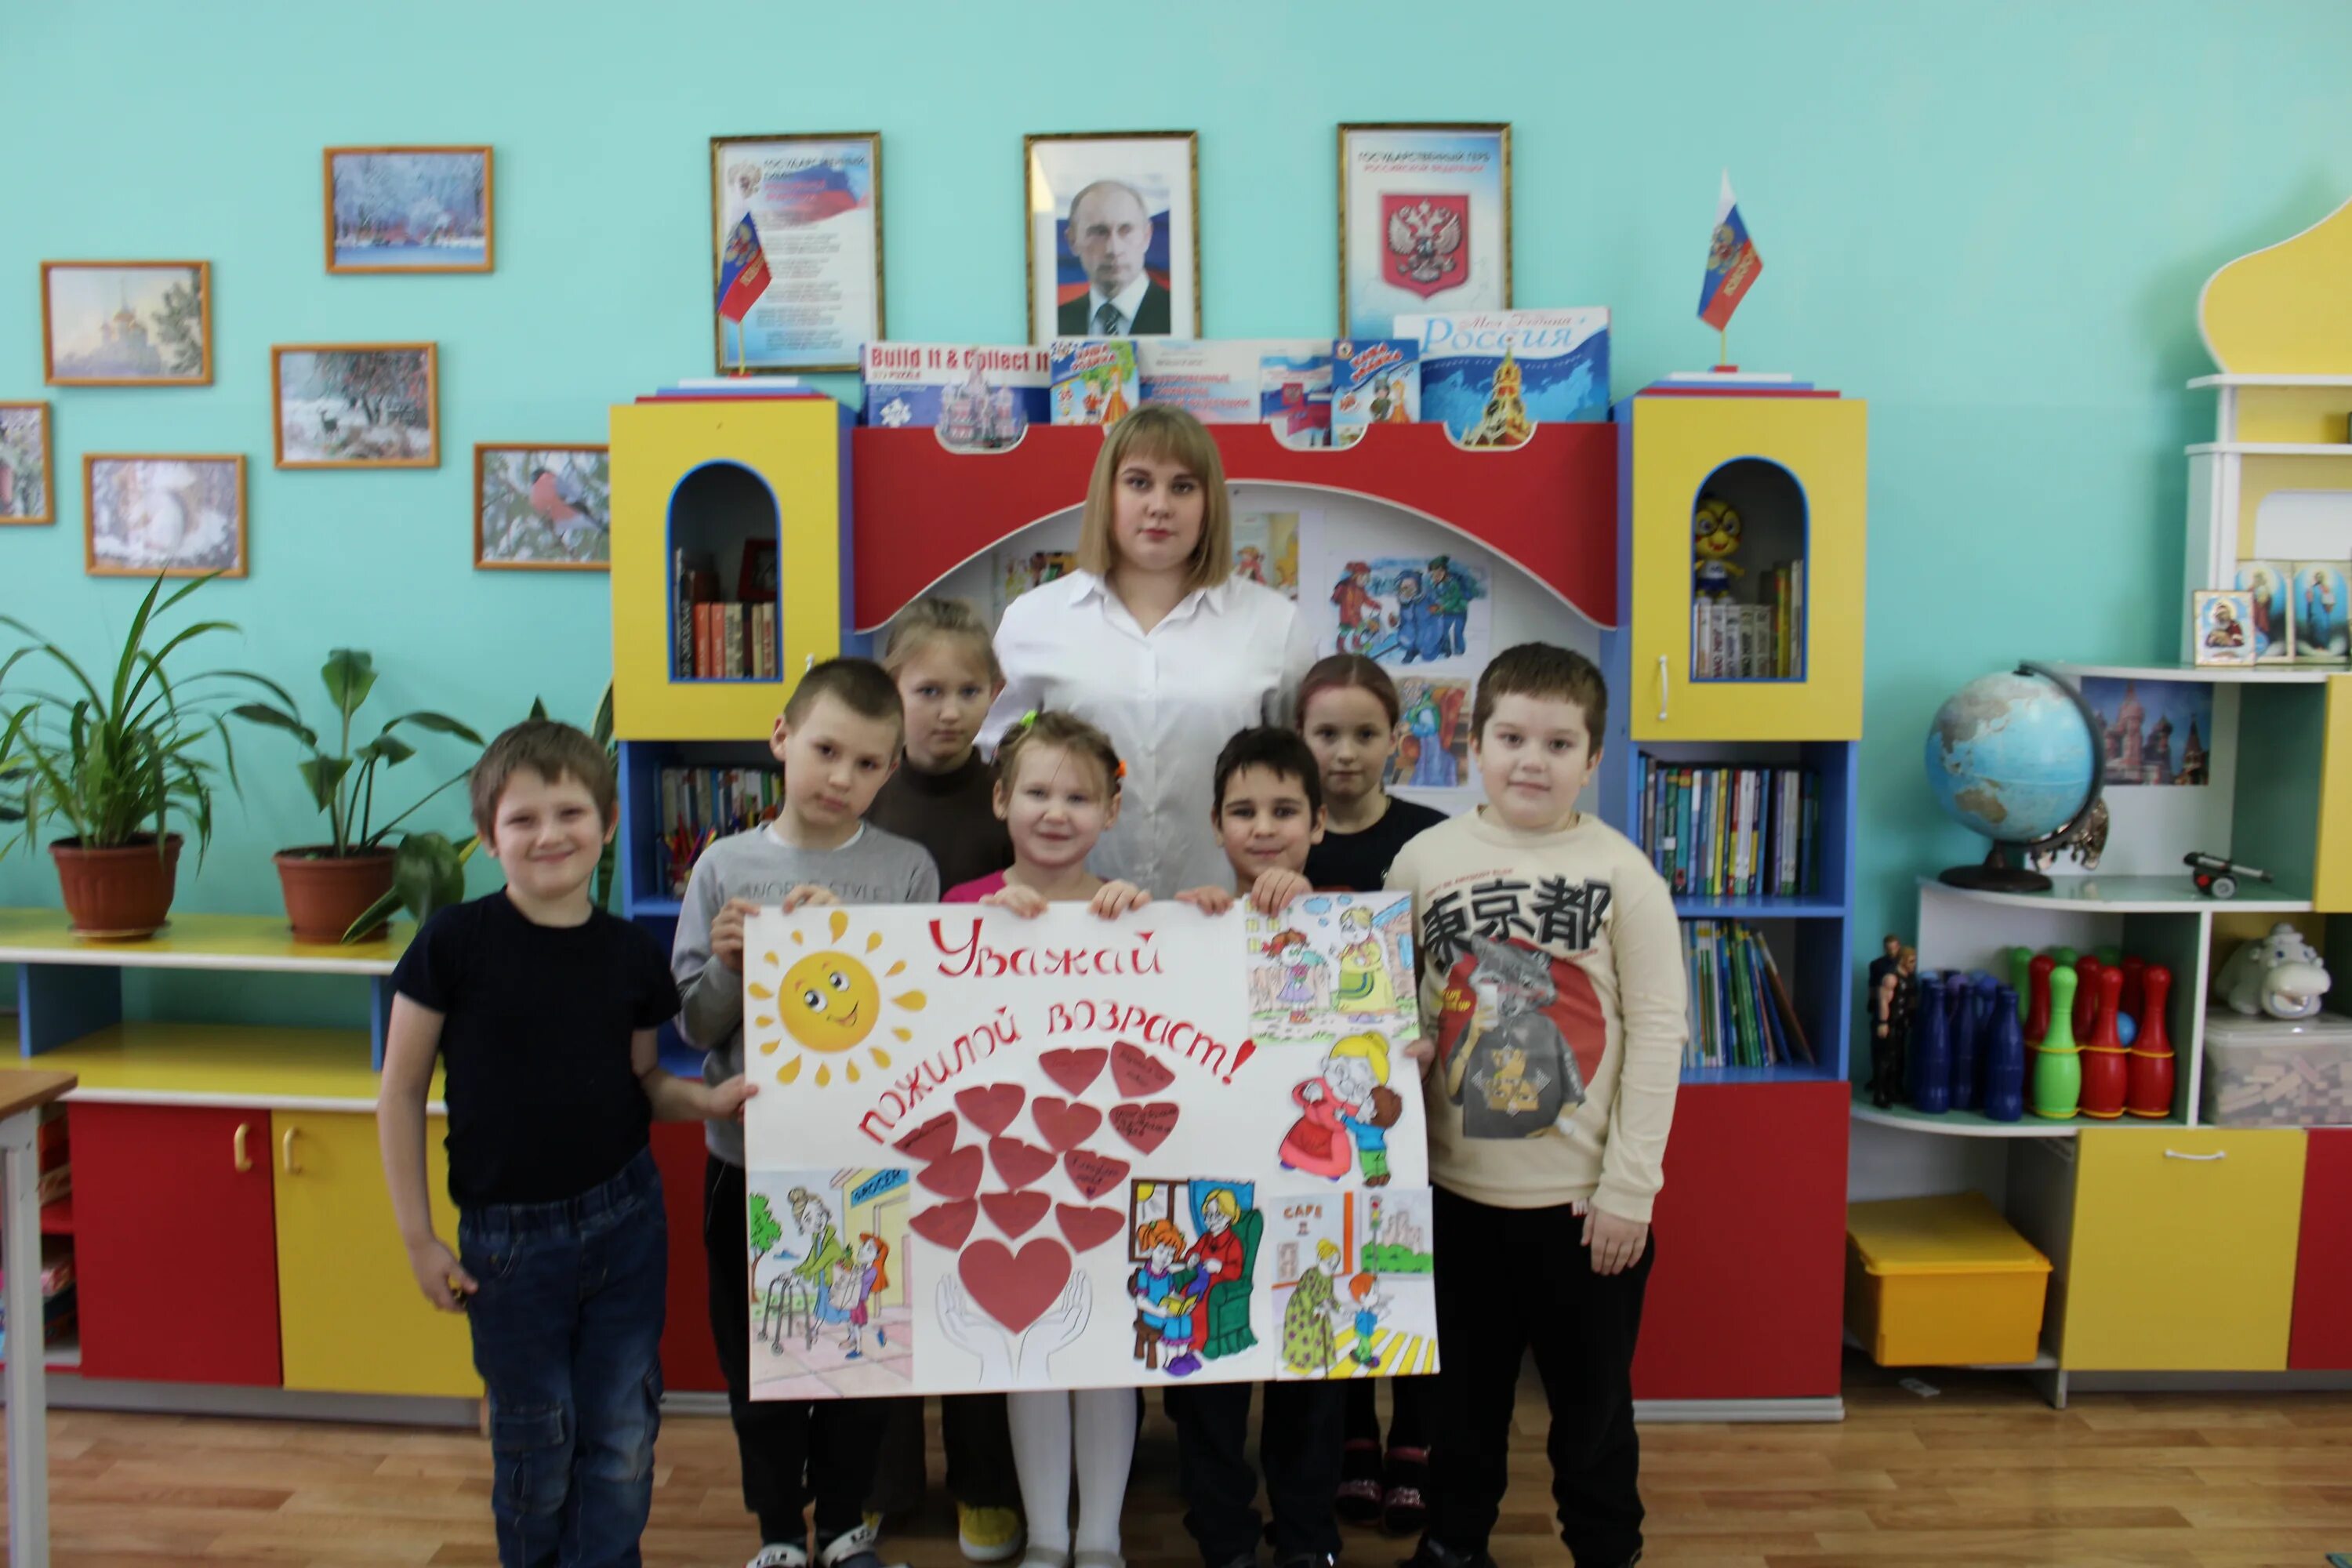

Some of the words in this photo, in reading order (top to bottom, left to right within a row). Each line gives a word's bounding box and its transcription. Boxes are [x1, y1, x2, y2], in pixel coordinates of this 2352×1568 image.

[871, 347, 920, 368] Build
[928, 347, 941, 369] It
[946, 348, 958, 369] &
[964, 350, 1030, 372] Collect
[1420, 317, 1572, 354] Россия
[928, 917, 1165, 978] Уважай
[858, 1005, 1022, 1145] пожилой
[1047, 999, 1258, 1086] возраст!
